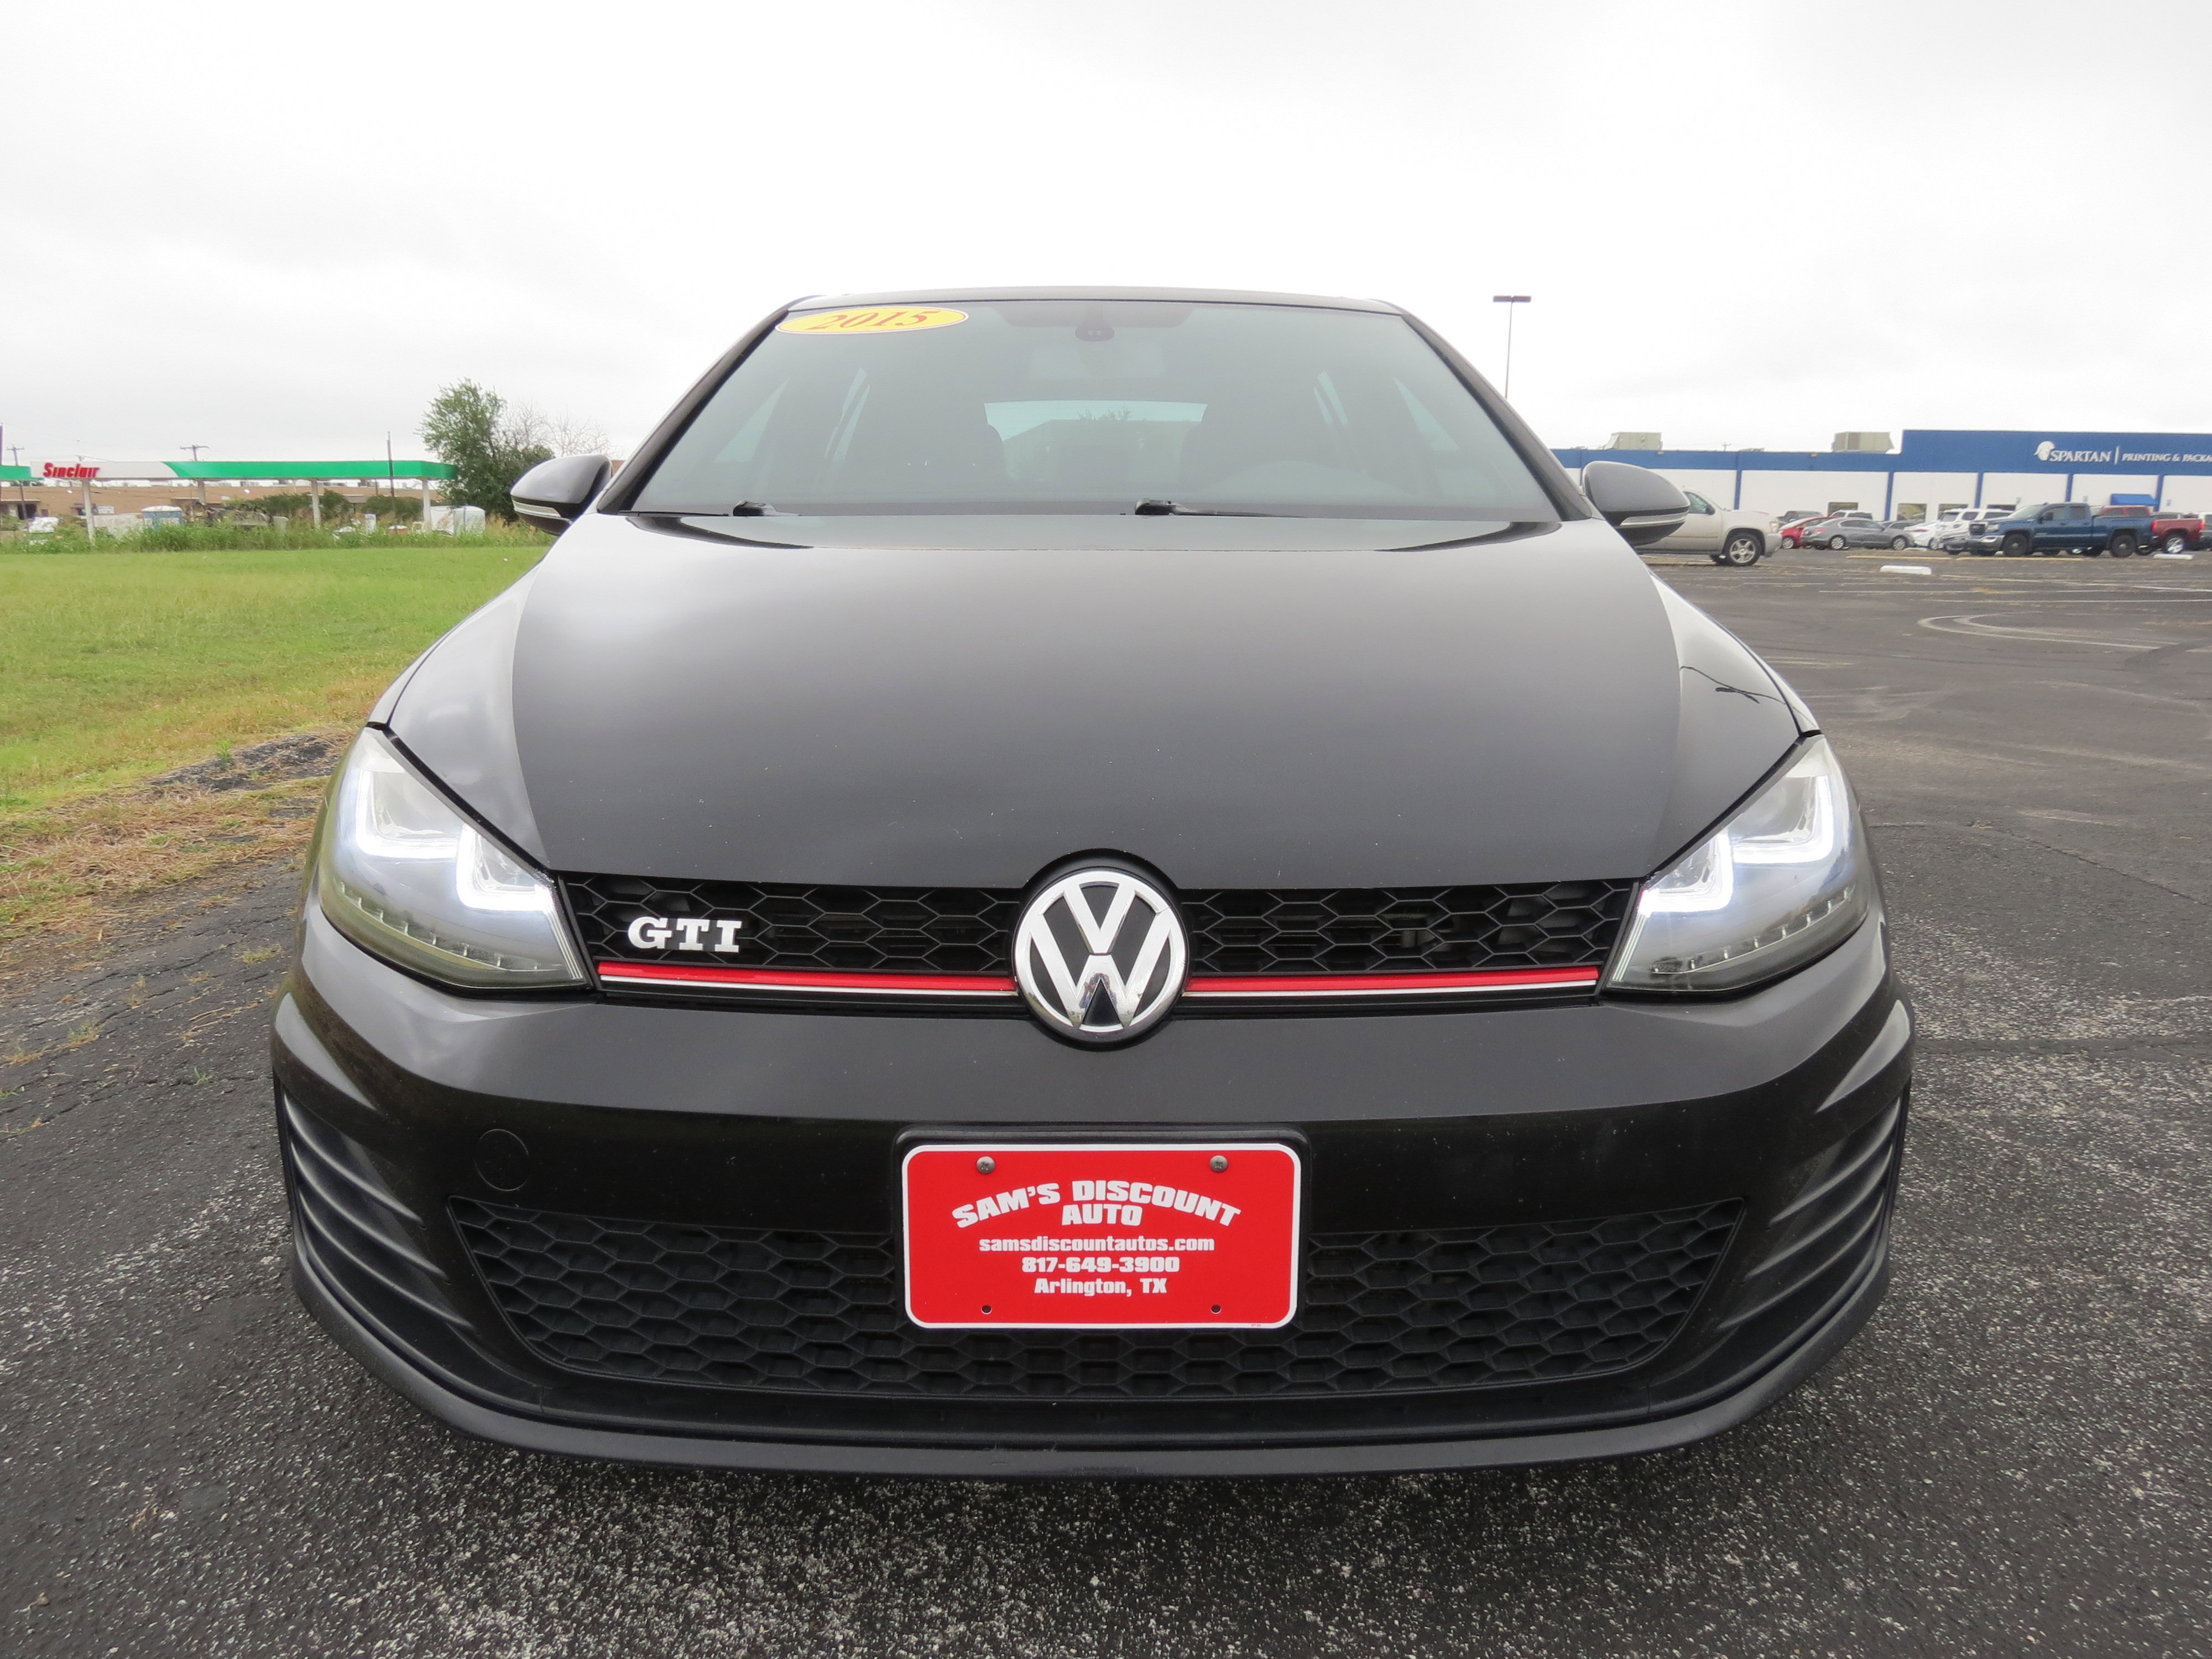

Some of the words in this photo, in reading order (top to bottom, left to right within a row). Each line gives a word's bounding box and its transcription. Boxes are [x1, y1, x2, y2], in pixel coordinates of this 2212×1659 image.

[804, 310, 941, 330] 2015
[2049, 450, 2111, 462] SPARTAN
[2122, 453, 2171, 462] PRINTING
[2172, 453, 2180, 462] &
[43, 462, 100, 478] Sinclair
[628, 916, 743, 953] GTI
[952, 1183, 1061, 1228] SAM'S
[1072, 1180, 1241, 1227] DISCOUNT
[1061, 1204, 1143, 1226] AUTO
[979, 1235, 1215, 1251] samsdiscountautos.com
[1022, 1256, 1180, 1273] 817-649-3900
[1034, 1278, 1132, 1297] Arlington,
[1140, 1278, 1167, 1293] TX
